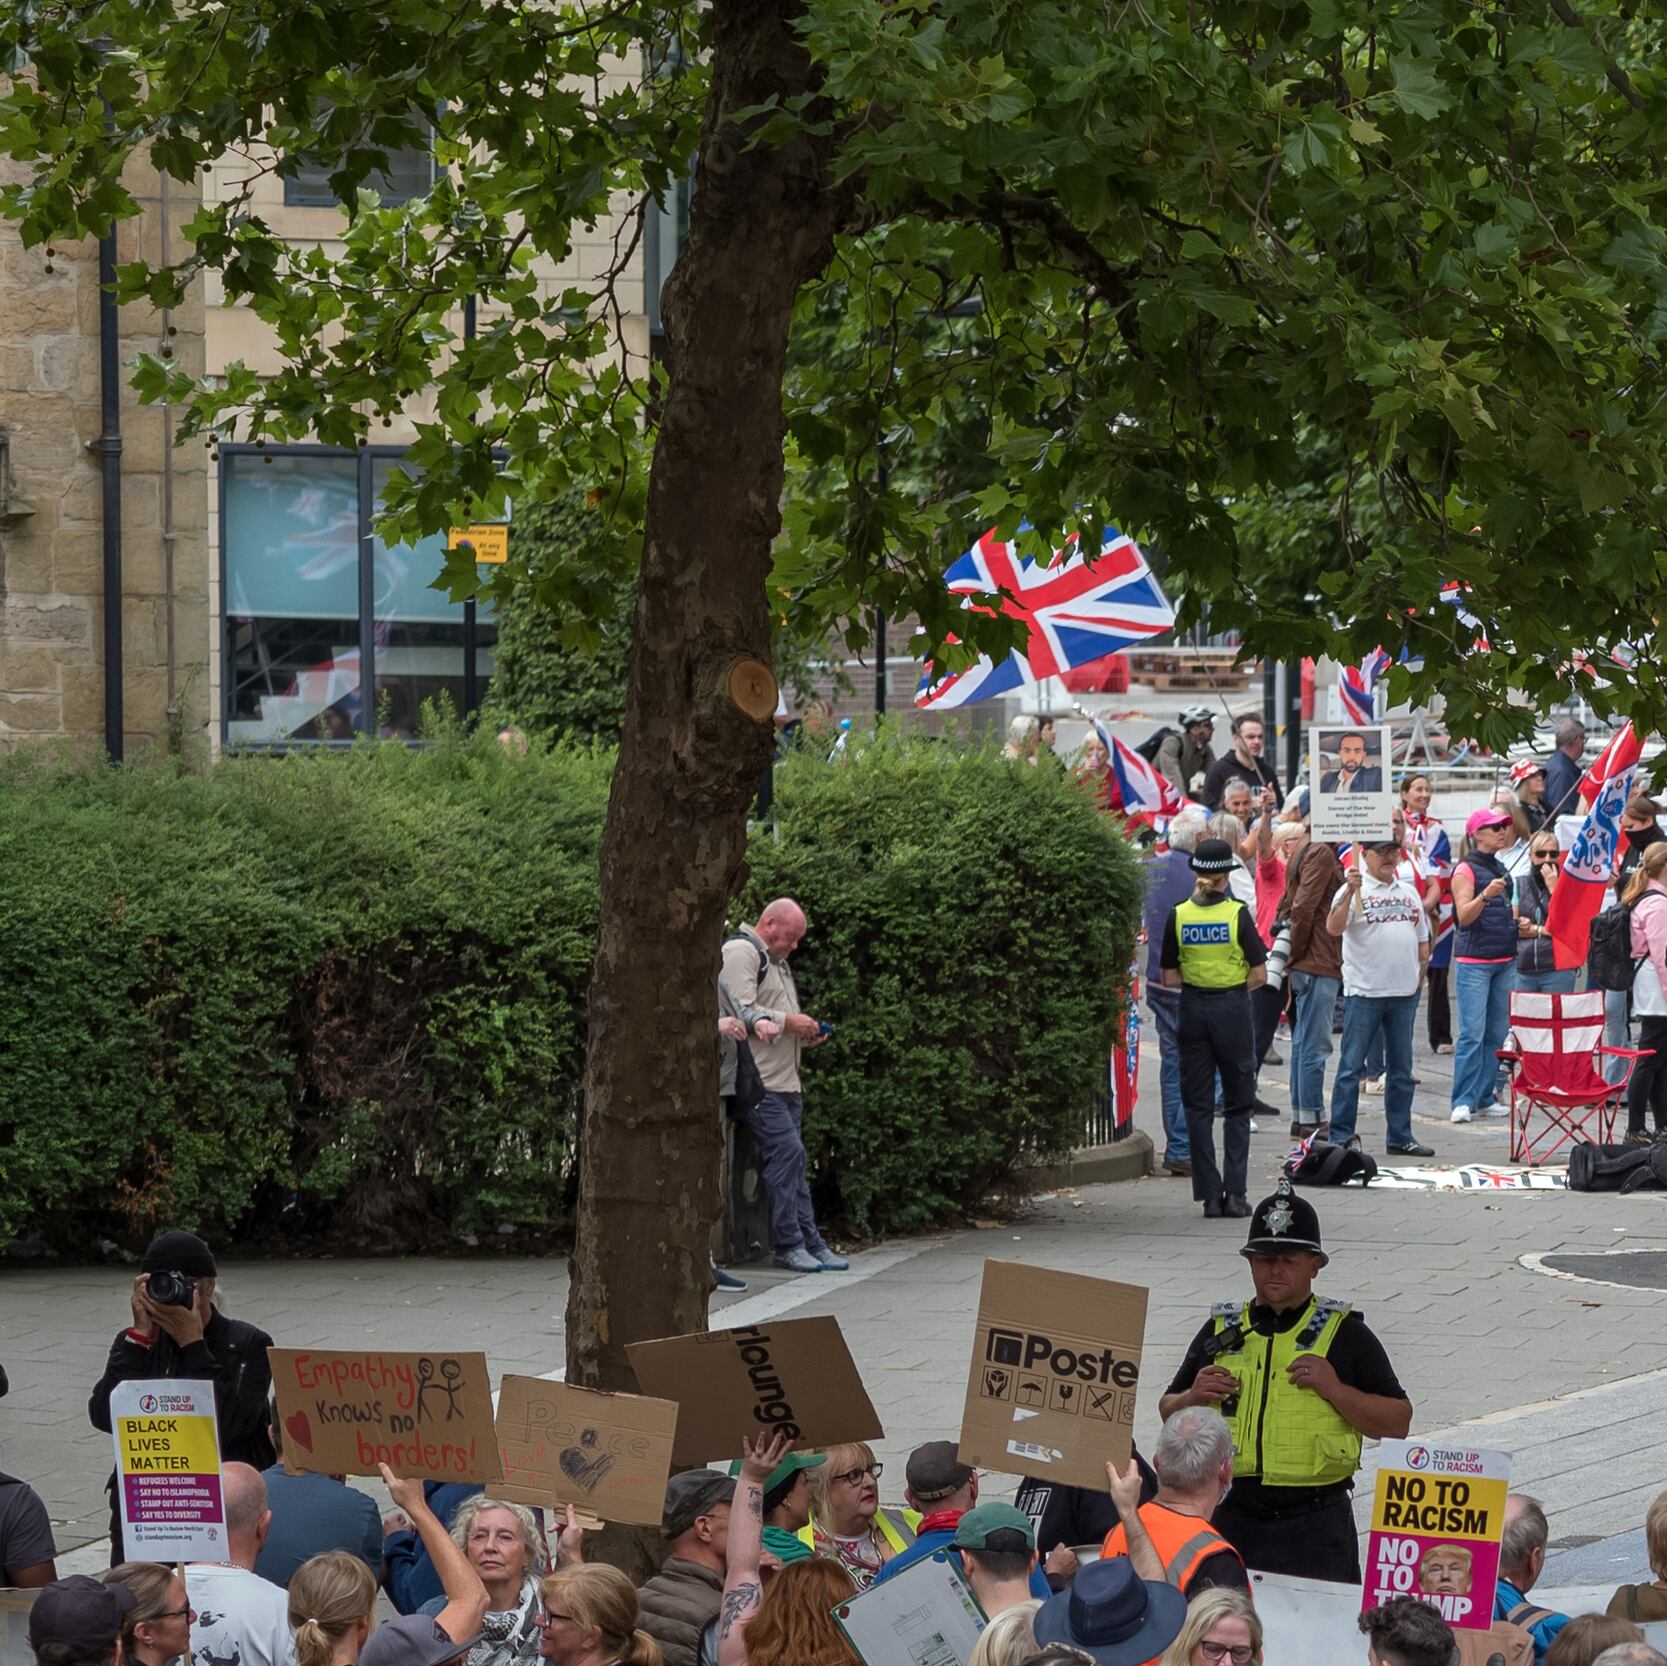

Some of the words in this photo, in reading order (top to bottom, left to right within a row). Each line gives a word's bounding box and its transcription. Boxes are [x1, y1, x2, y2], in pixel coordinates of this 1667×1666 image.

[1182, 926, 1229, 942] POLICE
[1023, 1334, 1138, 1388] Poste
[294, 1355, 416, 1410] Empathy
[159, 1395, 181, 1403] STAND
[160, 1403, 169, 1412] TO
[170, 1404, 194, 1412] RACISM
[127, 1420, 177, 1433] BLACK
[390, 1414, 414, 1433] no
[523, 1399, 650, 1459] Peace
[129, 1438, 170, 1451] LIVES
[356, 1429, 476, 1475] borders!
[130, 1457, 189, 1470] MATTER
[1433, 1450, 1463, 1461] STAND
[1466, 1452, 1479, 1463] UP
[1432, 1461, 1445, 1471] TO
[1446, 1462, 1483, 1474] RACISM
[1386, 1475, 1425, 1503] NO
[1435, 1480, 1470, 1506] TO
[1383, 1502, 1488, 1535] RACISM
[1378, 1536, 1419, 1565] NO
[1377, 1563, 1414, 1591] TO
